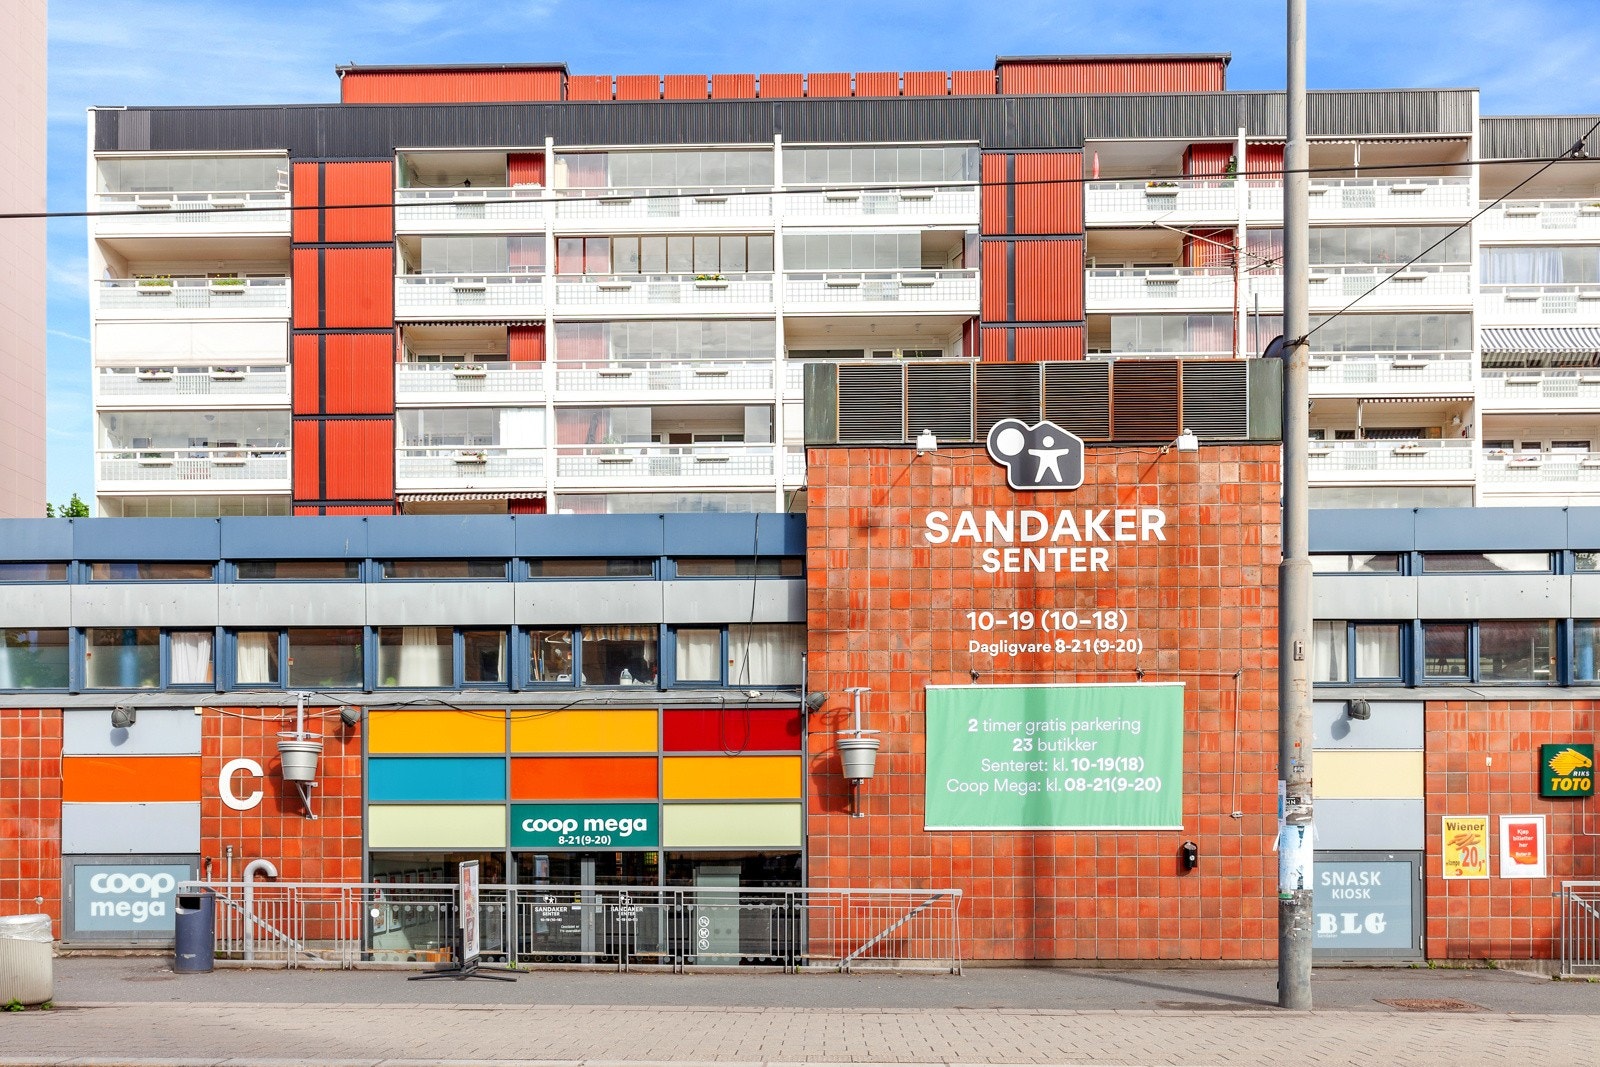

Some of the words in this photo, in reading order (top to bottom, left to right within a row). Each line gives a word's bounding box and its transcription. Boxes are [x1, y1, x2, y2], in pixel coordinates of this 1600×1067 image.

[925, 509, 1166, 543] SANDAKER
[982, 547, 1109, 572] SENTER
[969, 640, 1051, 656] Dagligvare
[1055, 638, 1143, 655] 8-21(9-20)
[968, 719, 978, 732] 2
[982, 719, 1022, 731] timer
[1025, 718, 1066, 736] gratis
[1071, 717, 1140, 735] parkering
[1013, 738, 1032, 752] 23
[1038, 737, 1097, 751] butikker
[981, 758, 1047, 772] Senteret:
[1053, 758, 1069, 771] kl.
[1071, 757, 1144, 772] 10-19(18)
[219, 758, 263, 810] C
[947, 779, 988, 795] Coop
[994, 778, 1040, 796] Mega:
[1046, 778, 1062, 791] kl.
[1065, 776, 1161, 792] 08-21(9-20)
[1551, 778, 1591, 791] TOTO
[522, 818, 578, 834] coop
[584, 818, 647, 837] mega
[1447, 822, 1484, 831] Wiener
[559, 836, 611, 845] 8-21(9-20)
[90, 873, 175, 898] coop
[1321, 871, 1381, 885] SNASK
[1332, 889, 1370, 899] KIOSK
[91, 901, 165, 922] mega
[1317, 913, 1387, 934] BLG
